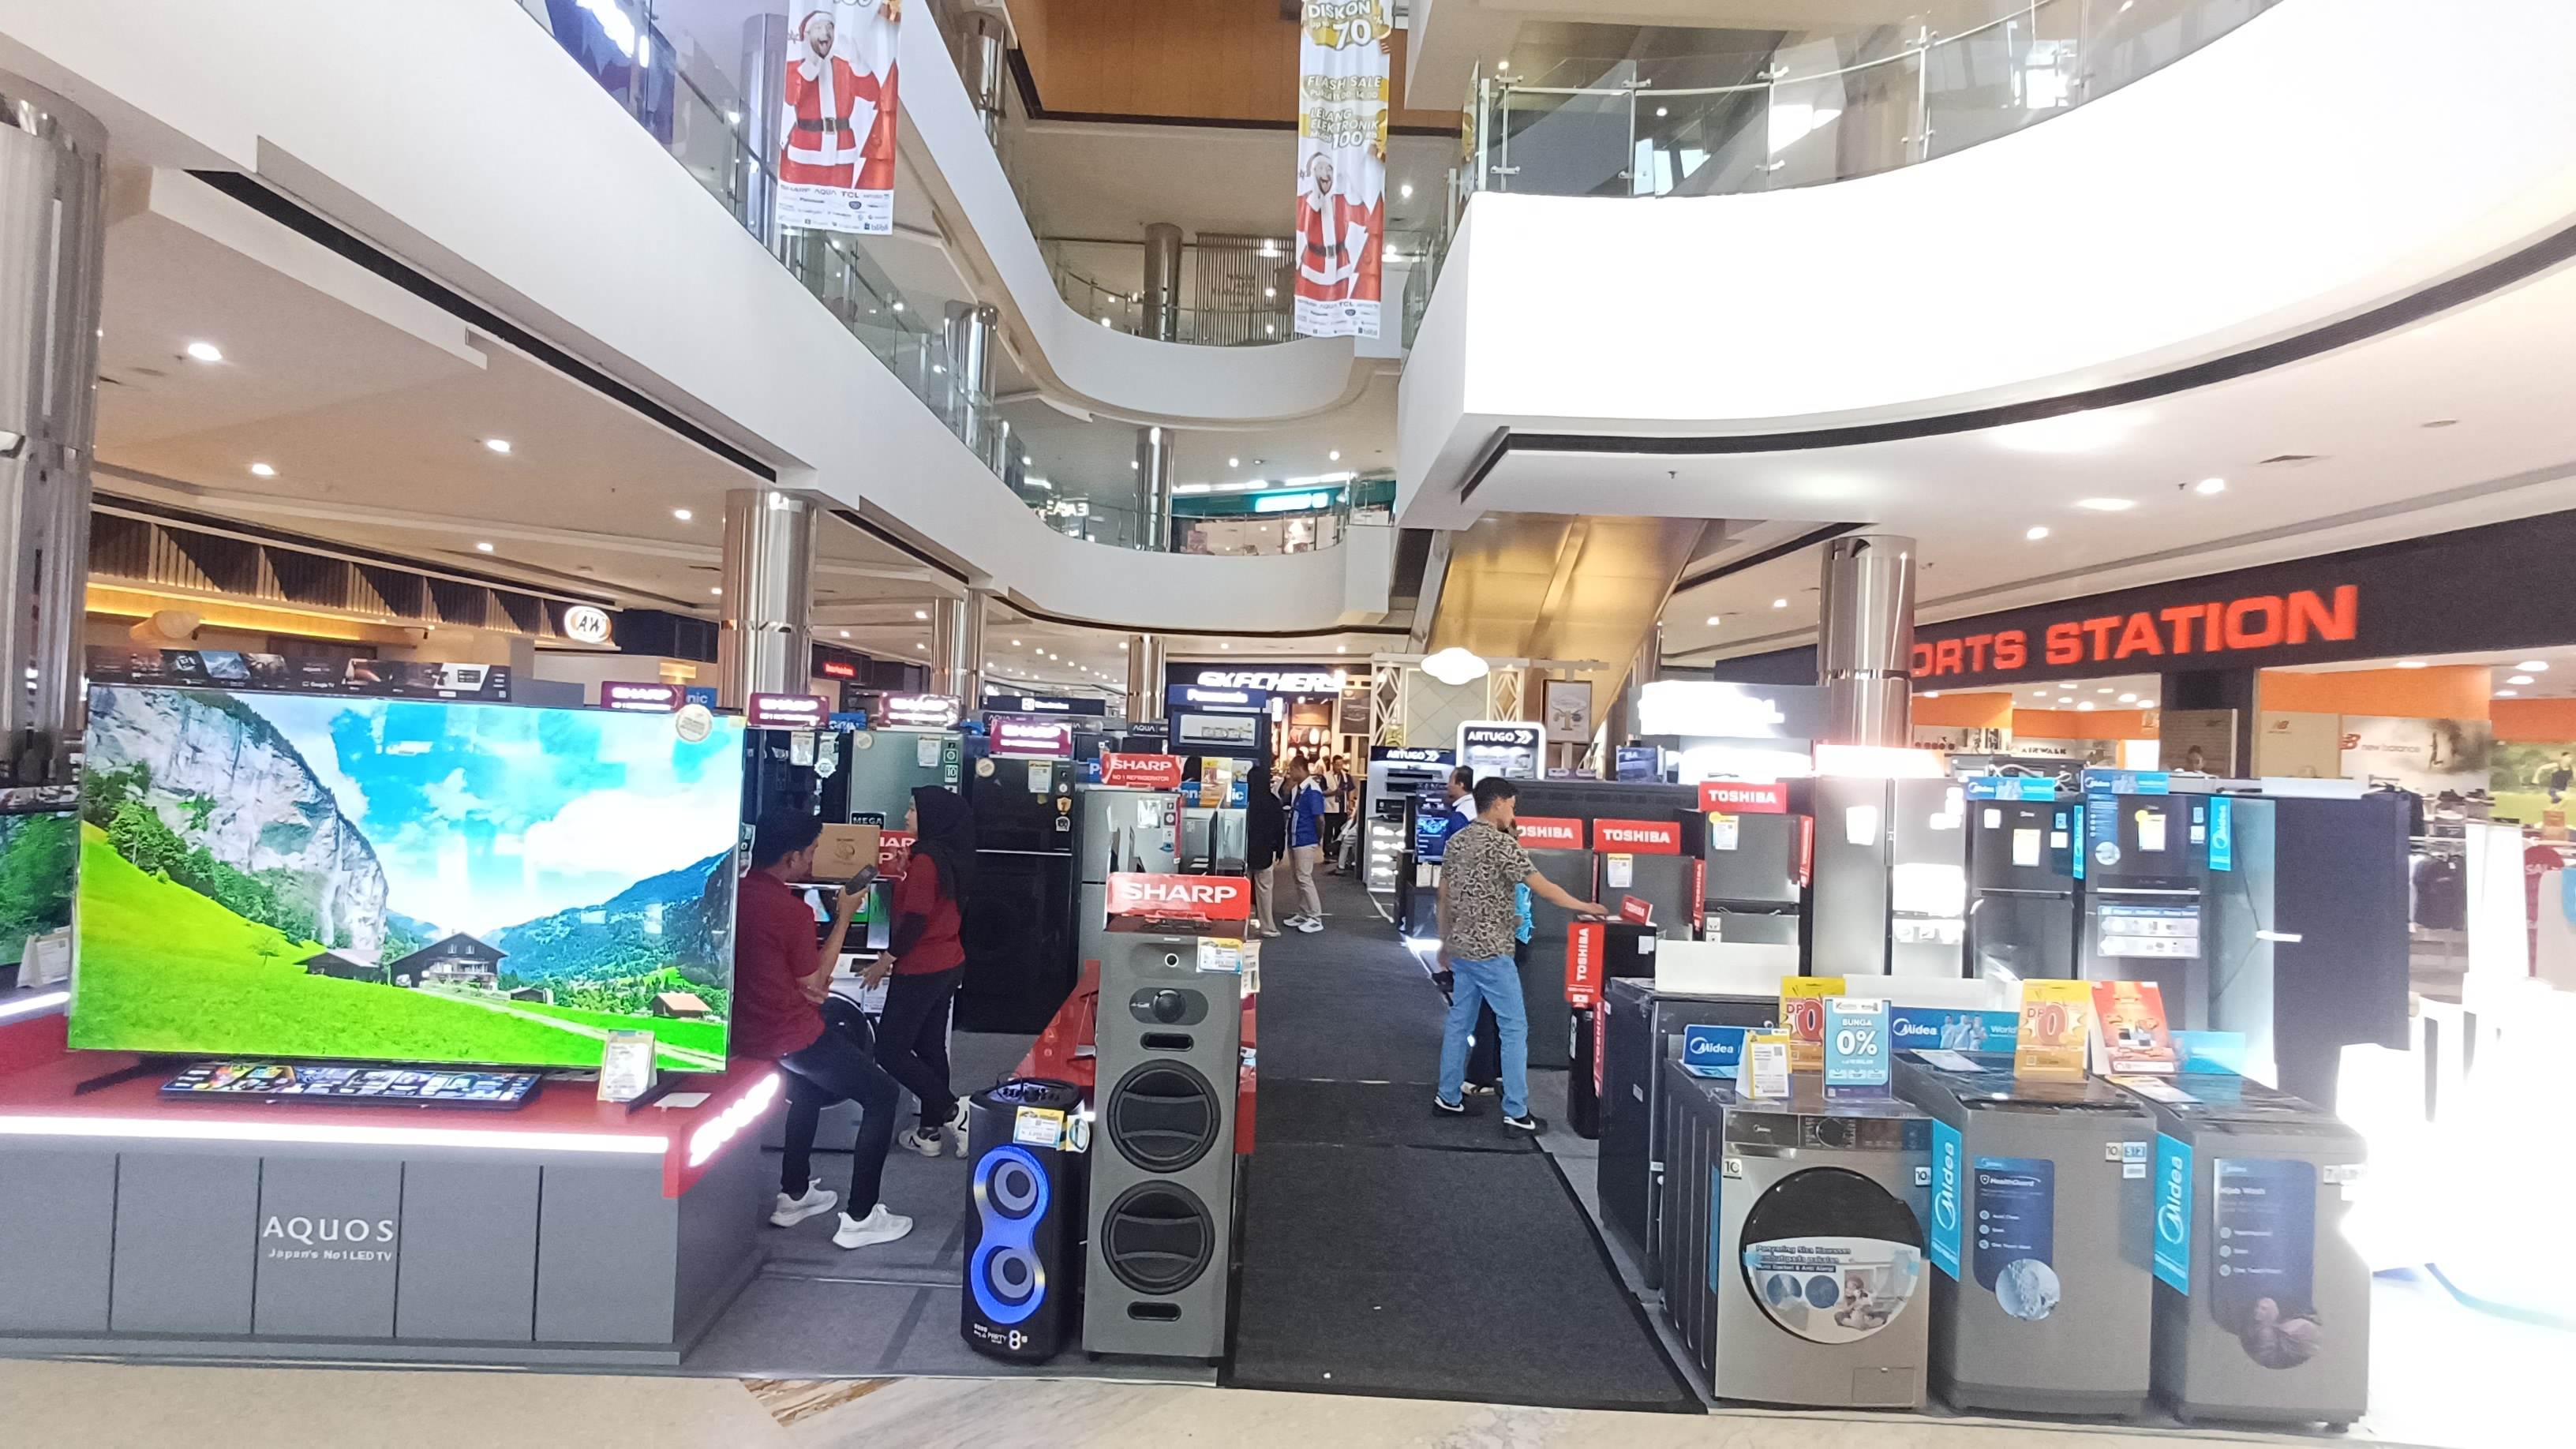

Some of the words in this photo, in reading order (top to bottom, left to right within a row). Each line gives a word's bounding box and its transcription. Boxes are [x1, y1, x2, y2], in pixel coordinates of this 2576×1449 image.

[1308, 1, 1371, 19] DISKON
[1307, 76, 1346, 90] FLASH
[1351, 77, 1382, 88] SALE
[1310, 107, 1353, 121] LELANG
[1310, 119, 1379, 133] ELEKTRONIK
[1331, 131, 1363, 149] 100
[1910, 630, 2027, 677] ORTS
[2046, 585, 2358, 666] STATION
[1468, 731, 1515, 742] ARTUGO
[1387, 750, 1425, 760] ARTUGO
[1113, 760, 1172, 771] SHARP
[1709, 789, 1777, 803] TOSHIBA
[1517, 826, 1573, 839] OSHIBA
[1603, 829, 1670, 843] TOSHIBA
[1121, 882, 1237, 904] SHARP
[1577, 927, 1589, 981] TOSHIBA
[1787, 1004, 1803, 1013] DP
[1842, 1018, 1873, 1027] BUNGA
[1893, 1018, 1938, 1036] Midea
[1690, 1037, 1734, 1054] Midea
[1837, 1029, 1878, 1055] 0%
[2107, 1147, 2118, 1155] 10
[1725, 1161, 1739, 1173] 10
[1917, 1171, 1926, 1181] 10
[1935, 1142, 1955, 1231] Midea
[2159, 1156, 2184, 1245] Midea
[263, 1216, 394, 1245] AQUOS
[268, 1249, 318, 1260] Japan's
[1009, 1330, 1021, 1350] 8
